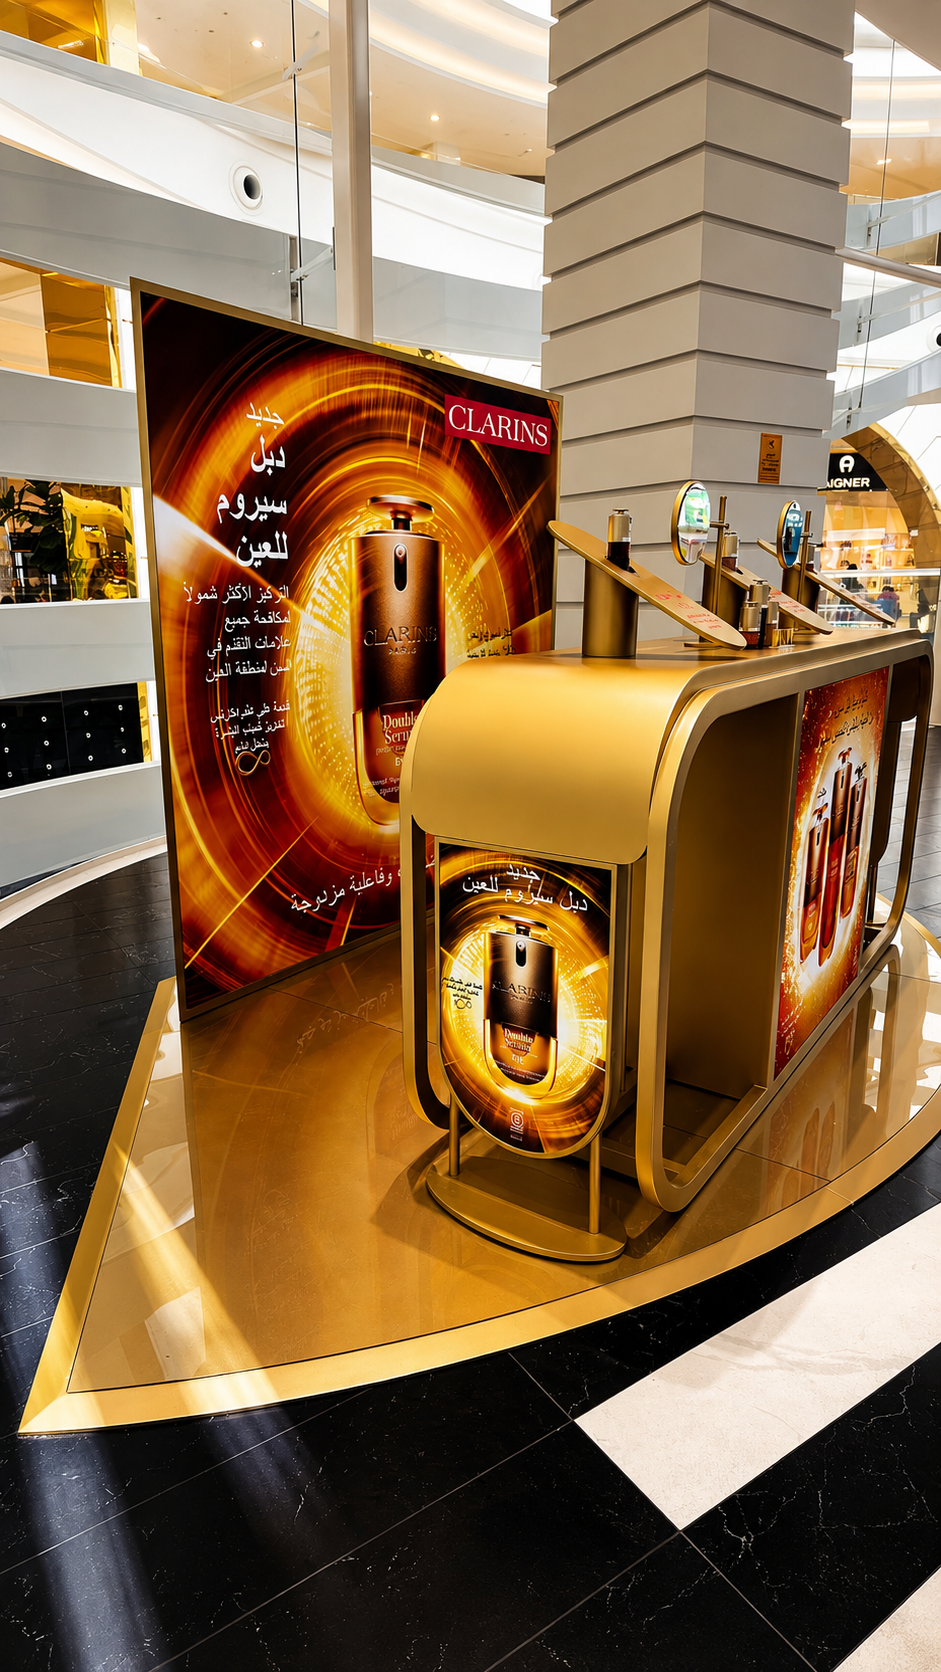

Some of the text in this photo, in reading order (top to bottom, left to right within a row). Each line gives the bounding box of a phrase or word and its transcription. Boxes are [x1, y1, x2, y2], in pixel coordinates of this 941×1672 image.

[246, 402, 285, 429] جديد
[448, 404, 548, 447] CLARINS
[250, 434, 286, 476] دبل
[216, 492, 288, 524] سيروم
[235, 530, 289, 568] للعين
[256, 584, 289, 604] التركيز
[224, 610, 291, 633] لمكافحة جميع
[206, 637, 223, 660] في
[363, 625, 438, 647] CLARINS
[384, 729, 411, 745] Seru
[506, 864, 541, 883] جديد
[462, 875, 588, 913] دبل سيروم للعين
